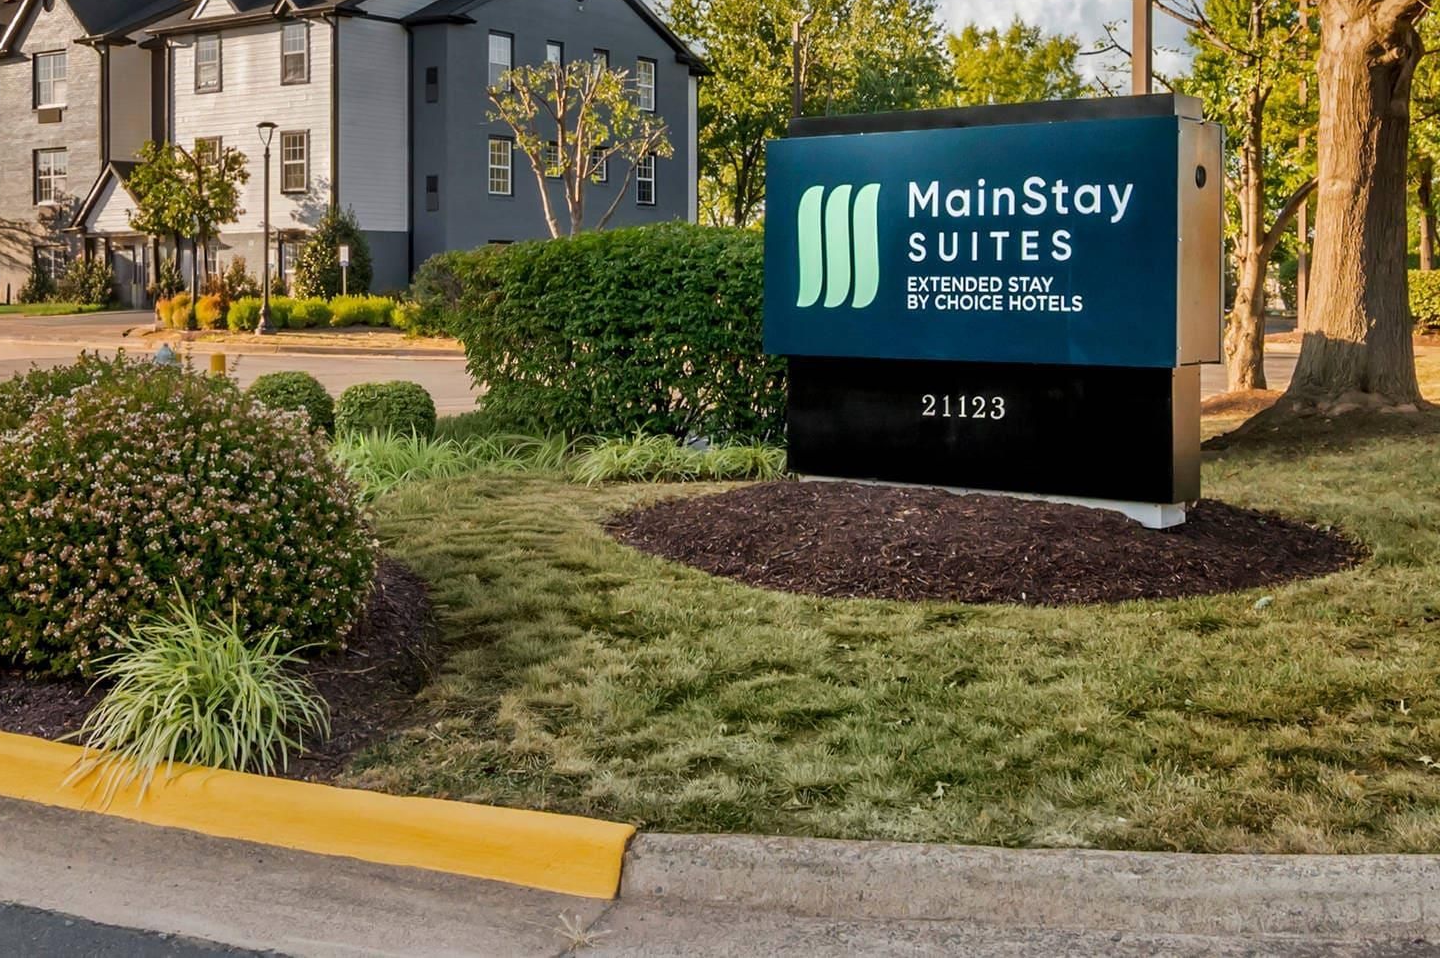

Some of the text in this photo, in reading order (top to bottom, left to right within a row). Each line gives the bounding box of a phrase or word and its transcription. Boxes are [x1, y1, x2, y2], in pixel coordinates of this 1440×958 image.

[908, 176, 1134, 224] MainStay
[908, 229, 1072, 262] SUITES
[907, 276, 1054, 292] EXTENDED STAY
[907, 294, 1084, 312] BY CHOICE HOTELS
[922, 394, 1006, 420] 21123
